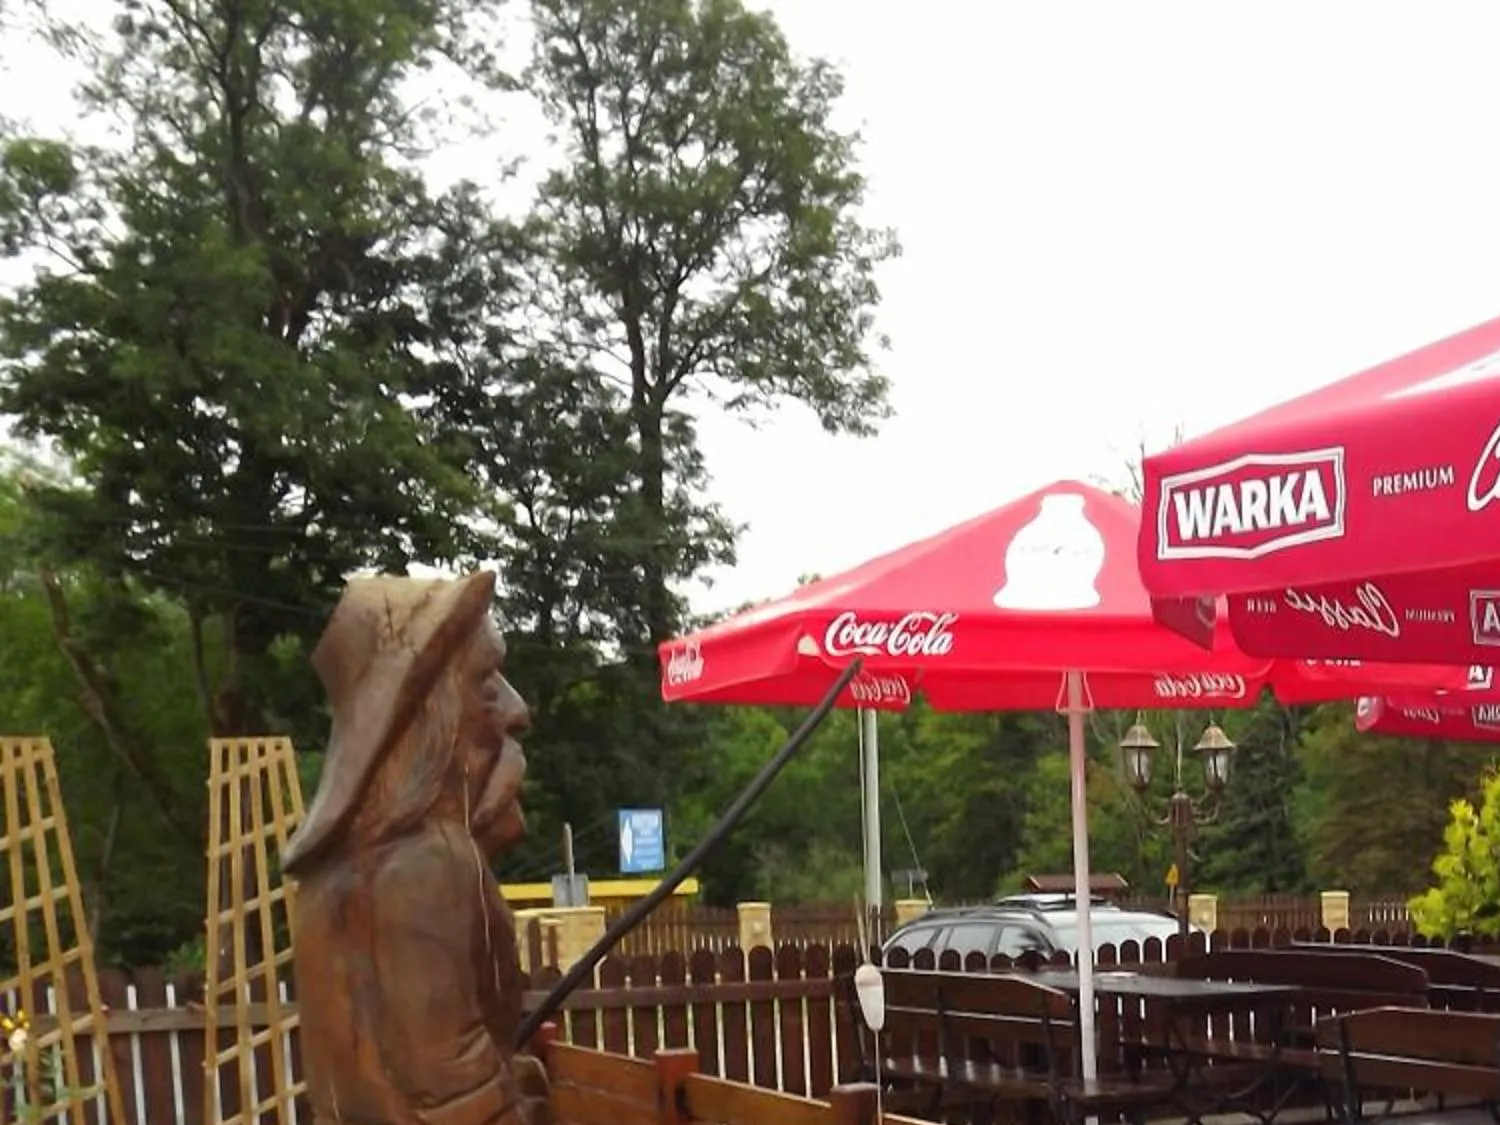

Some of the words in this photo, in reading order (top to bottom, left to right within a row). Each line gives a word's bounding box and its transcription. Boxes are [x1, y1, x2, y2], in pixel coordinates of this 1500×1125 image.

[1172, 468, 1331, 541] WARKA
[1371, 465, 1455, 497] PREMIUM
[824, 610, 959, 656] Coca-Cola
